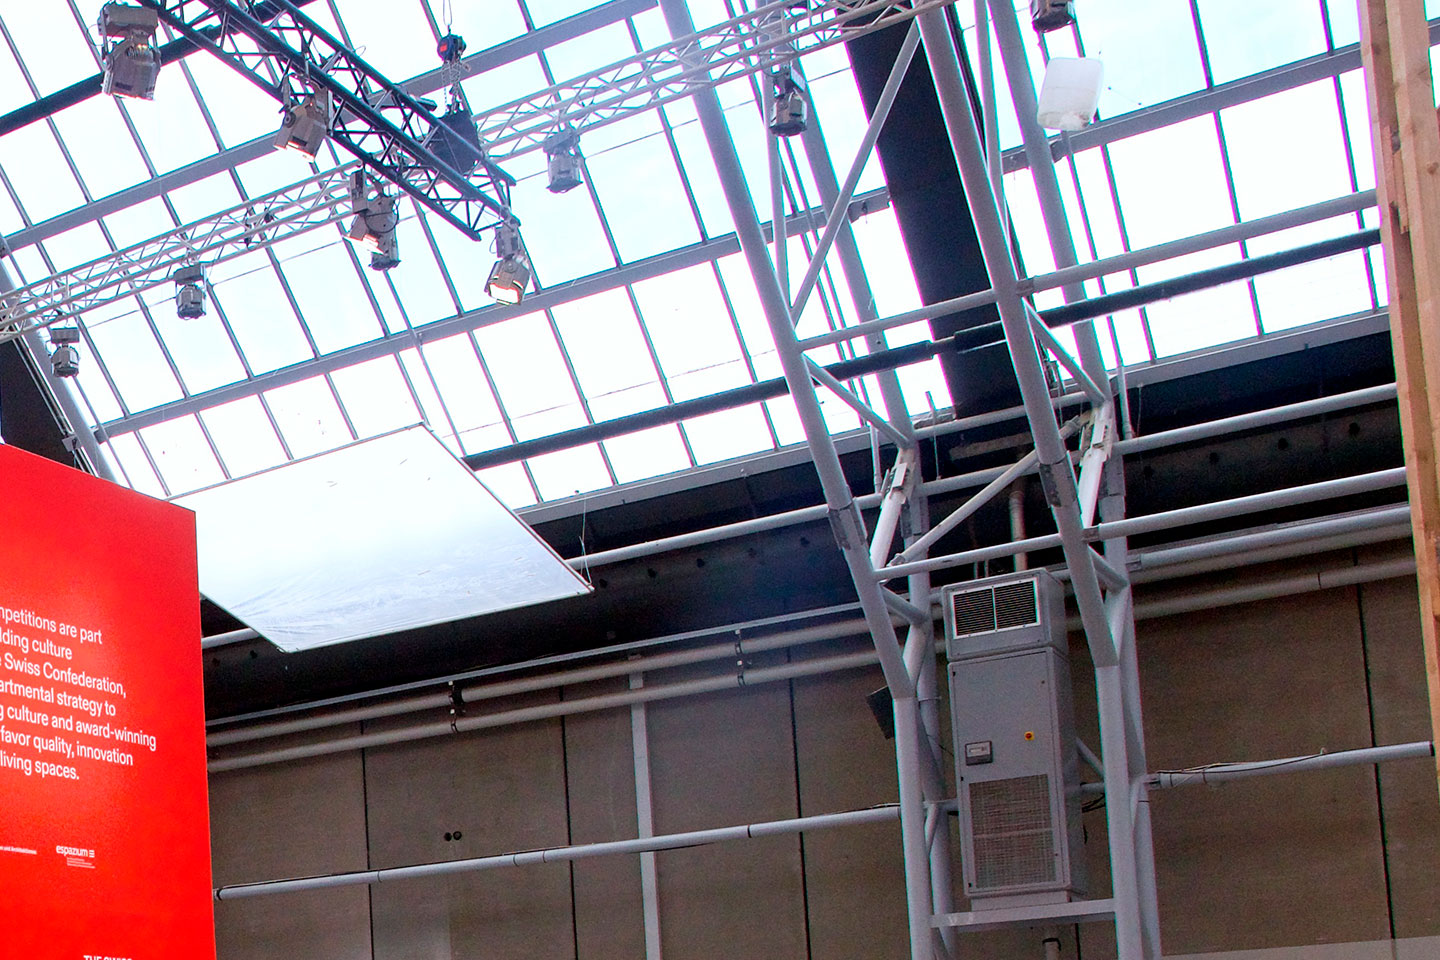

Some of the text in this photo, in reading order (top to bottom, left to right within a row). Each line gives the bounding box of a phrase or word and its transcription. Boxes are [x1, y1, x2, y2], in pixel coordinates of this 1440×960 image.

[59, 623, 77, 638] are
[80, 628, 102, 644] part
[32, 639, 72, 660] culture
[4, 652, 40, 676] Swiss
[43, 662, 126, 698] Confederation,
[57, 692, 102, 717] strategy
[104, 701, 116, 716] to
[7, 705, 48, 726] culture
[52, 716, 73, 731] and
[76, 721, 156, 751] award-winning
[0, 726, 31, 746] favor
[33, 736, 74, 758] quality,
[77, 741, 133, 766] innovation
[0, 750, 32, 776] living
[35, 761, 79, 780] spaces.
[56, 846, 88, 857] espazium
